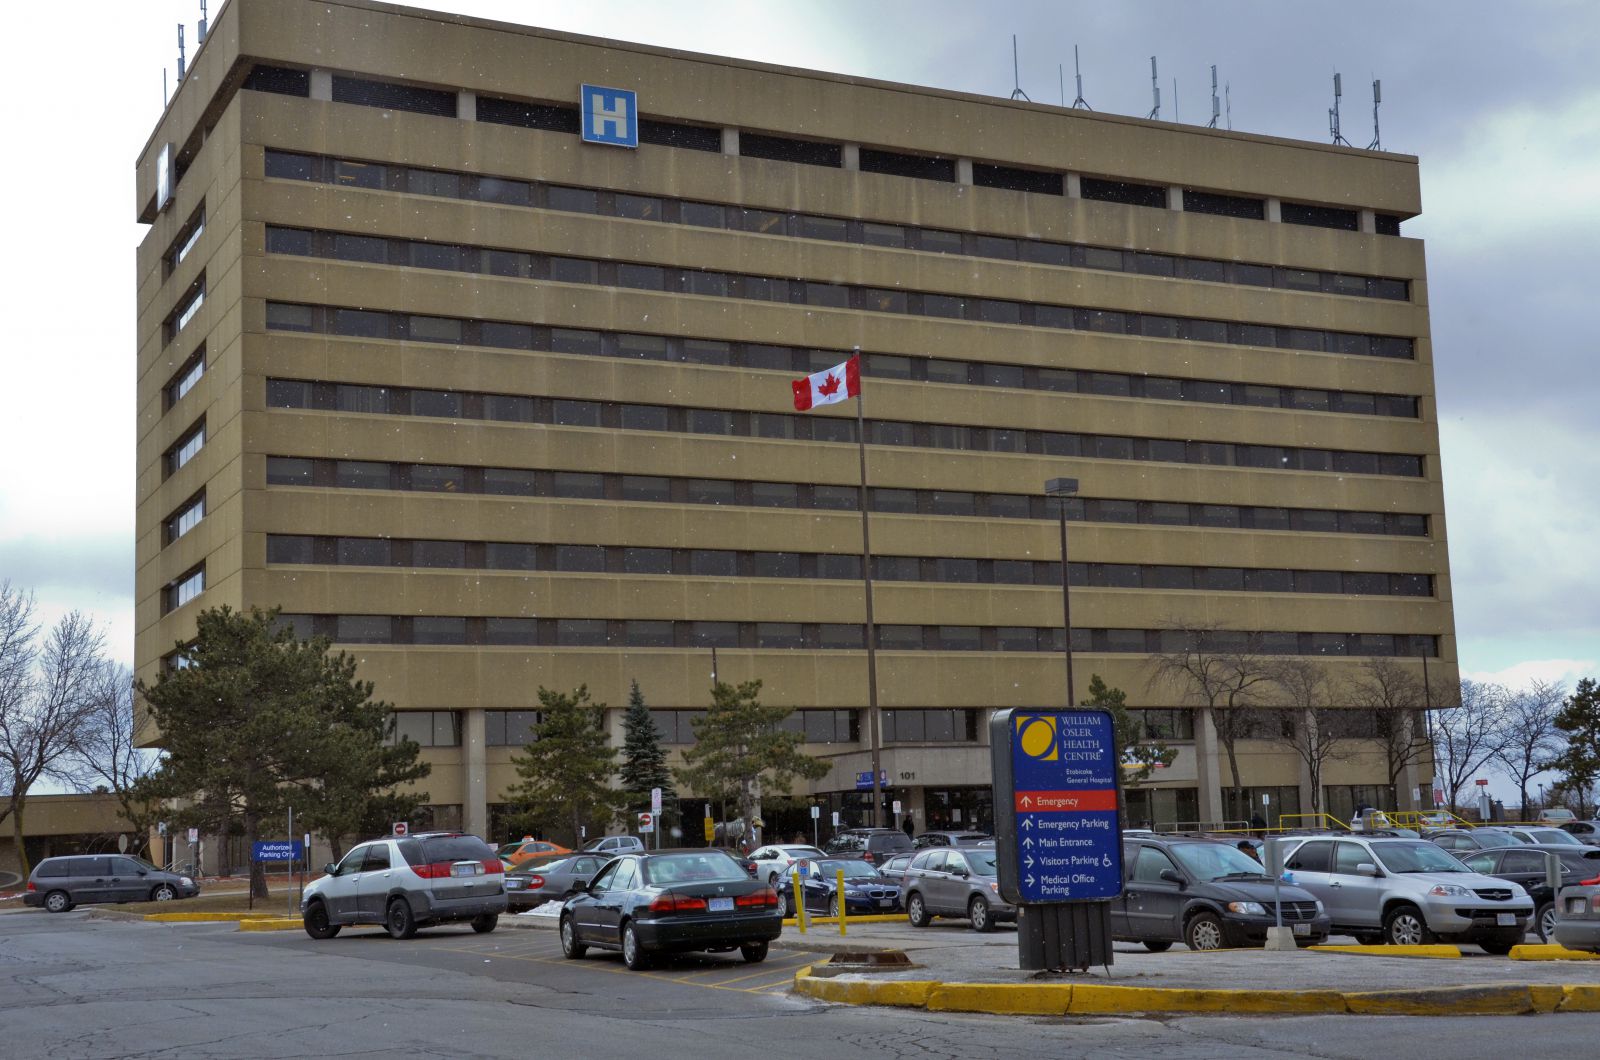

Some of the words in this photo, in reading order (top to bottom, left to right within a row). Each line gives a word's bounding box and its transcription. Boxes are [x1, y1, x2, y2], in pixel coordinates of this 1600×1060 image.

[592, 94, 627, 138] H
[1061, 716, 1101, 725] WILLIAM
[1062, 728, 1092, 737] OSLER
[1063, 740, 1100, 749] HEALTH
[1064, 752, 1101, 761] CENTRE
[899, 771, 916, 780] 101
[1090, 776, 1112, 784] Hospital
[1037, 797, 1078, 807] Emergency
[1038, 820, 1079, 830] Emergency
[1081, 819, 1109, 830] Parking
[1039, 838, 1057, 847] Main
[1059, 837, 1093, 847] Entrance
[1040, 857, 1069, 866] Visitors
[1071, 856, 1099, 867] Parking
[1040, 875, 1070, 884] Medical
[1072, 874, 1095, 883] Office
[1041, 886, 1070, 896] Parking
